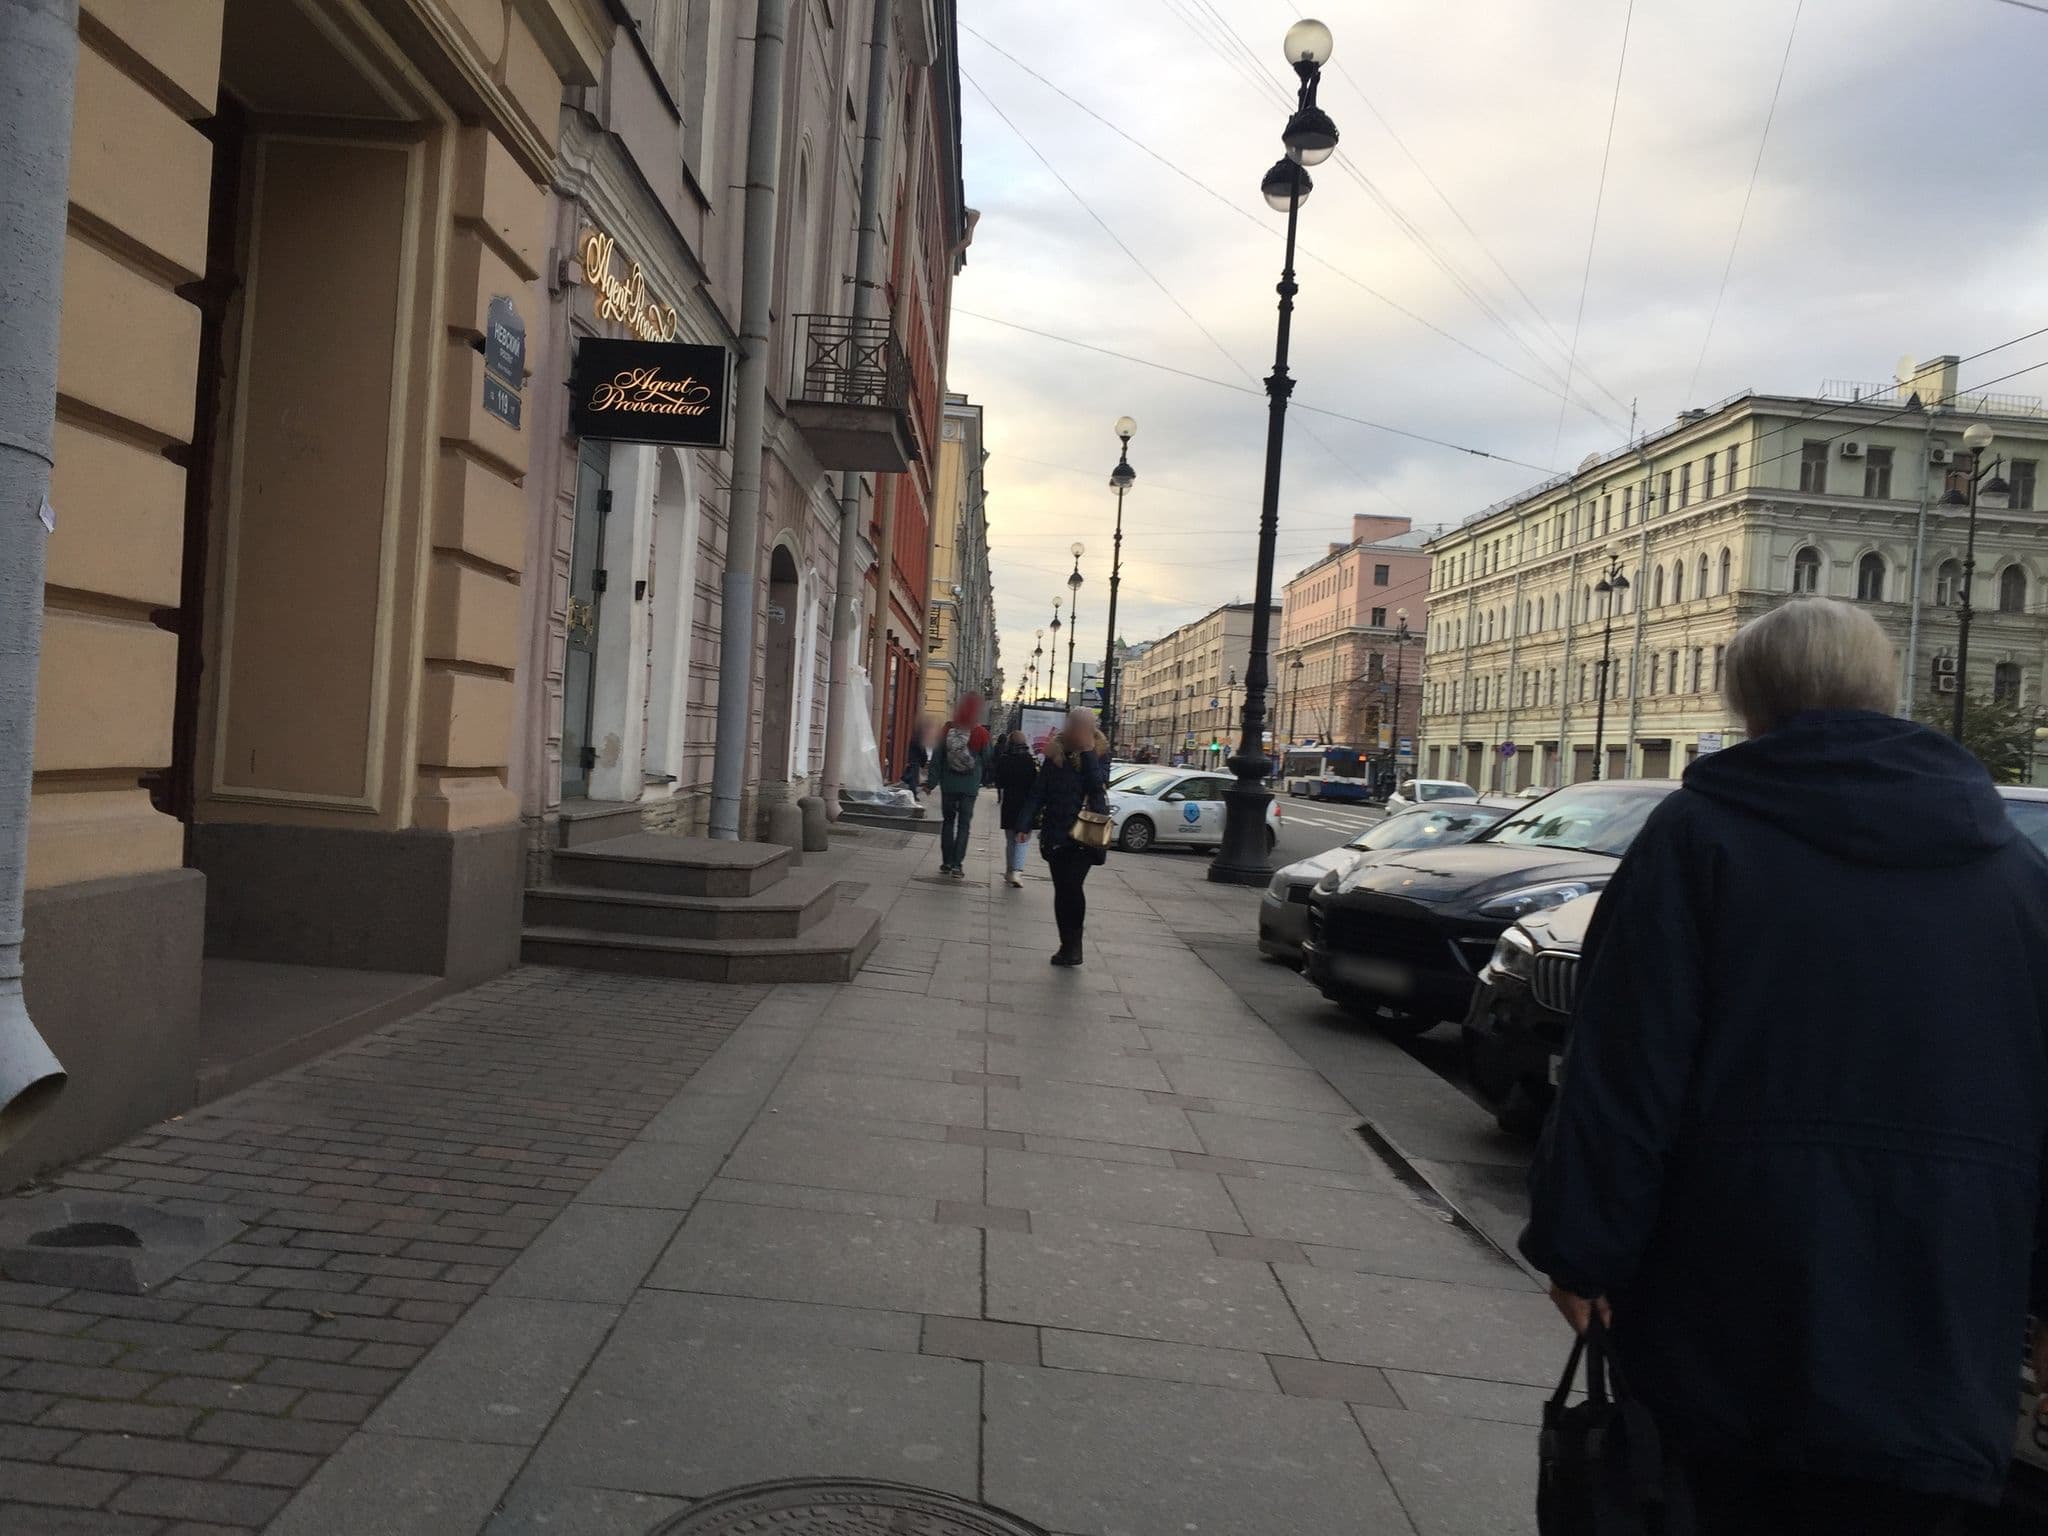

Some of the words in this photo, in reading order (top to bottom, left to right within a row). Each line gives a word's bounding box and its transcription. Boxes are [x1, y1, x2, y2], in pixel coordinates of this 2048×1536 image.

[586, 232, 632, 321] Agent
[628, 263, 677, 342] Provoc
[588, 383, 710, 416] Provocateur
[614, 366, 710, 404] Agent
